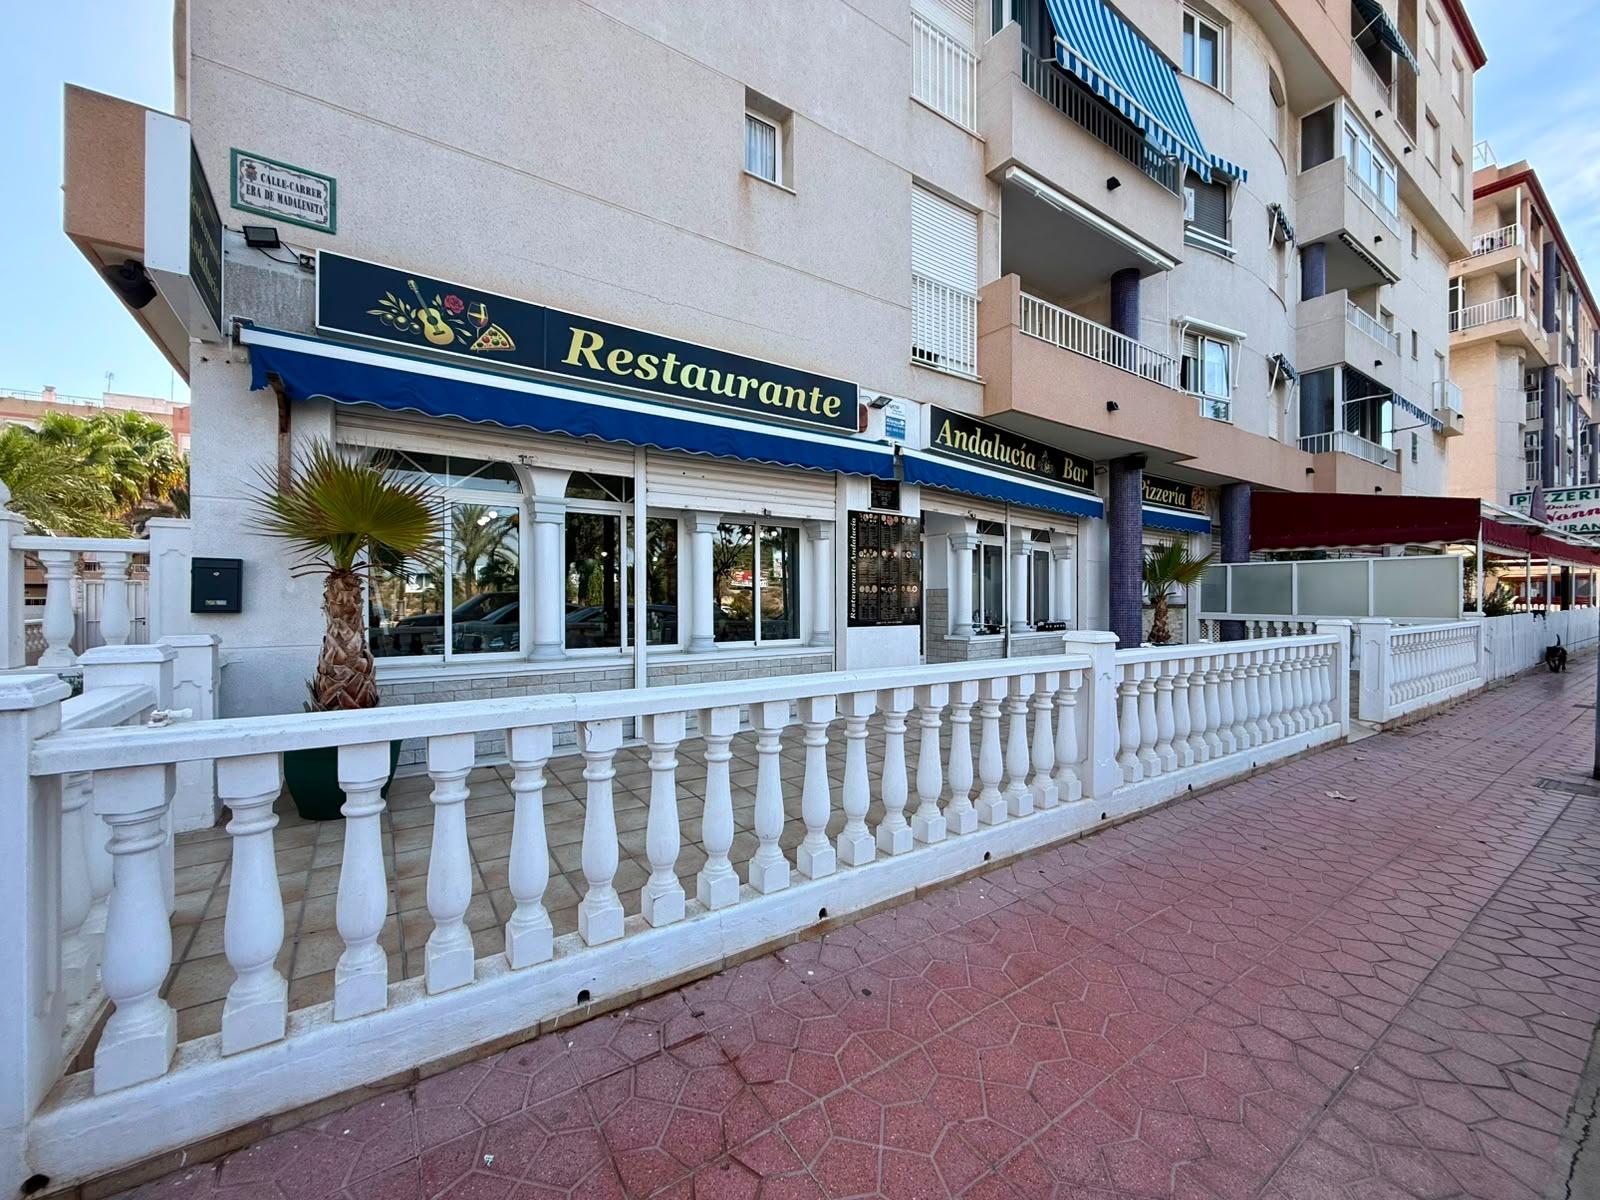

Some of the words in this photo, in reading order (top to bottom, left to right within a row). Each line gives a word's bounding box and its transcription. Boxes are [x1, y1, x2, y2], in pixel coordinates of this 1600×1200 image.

[246, 184, 261, 198] ERA
[264, 189, 274, 201] DE
[277, 193, 323, 216] MADALENETA
[260, 173, 322, 199] CALLE-CARRER
[561, 326, 841, 417] Restaurante
[935, 419, 1036, 471] Andalucía
[1062, 457, 1088, 483] Bar
